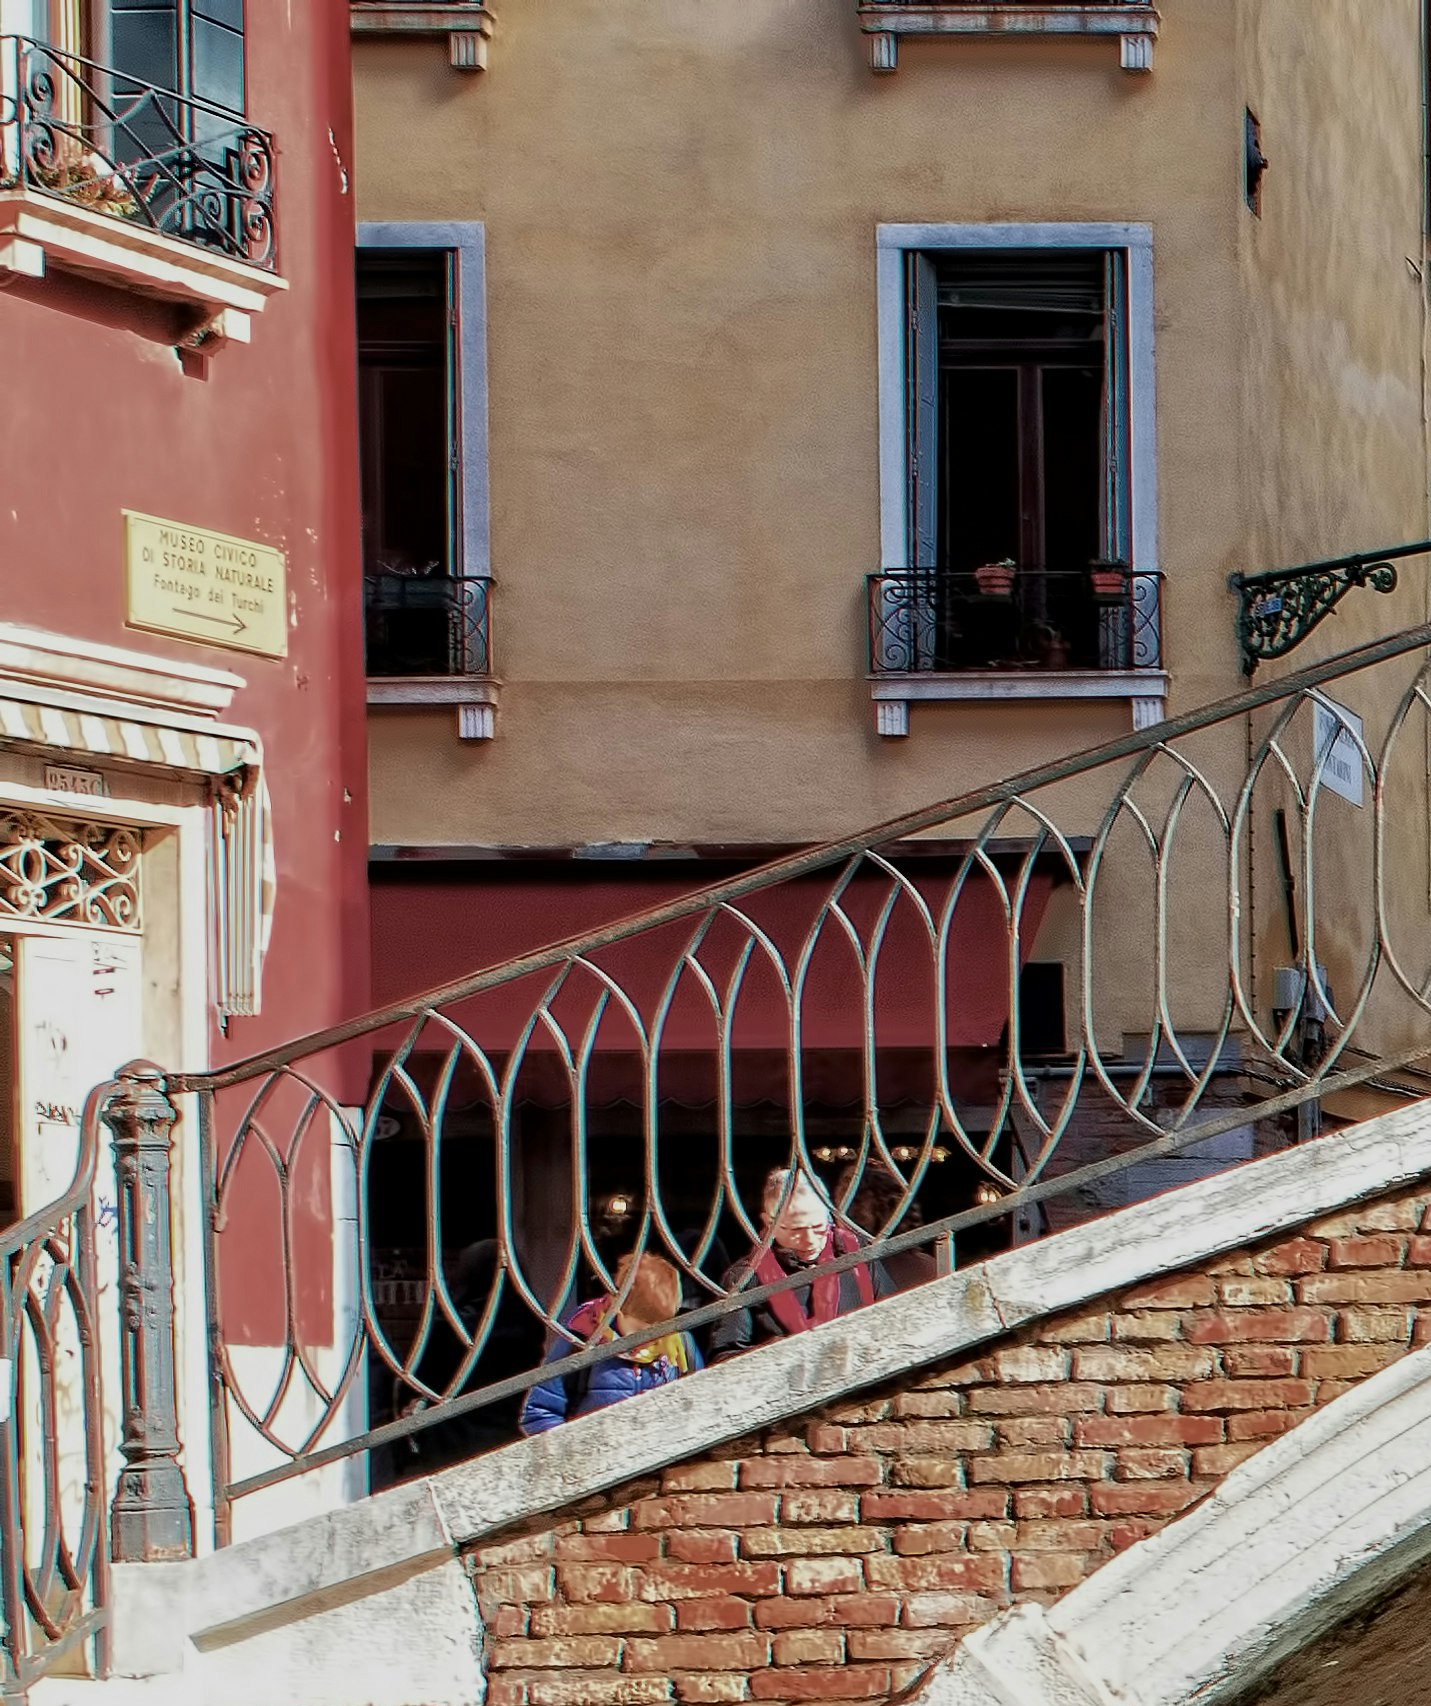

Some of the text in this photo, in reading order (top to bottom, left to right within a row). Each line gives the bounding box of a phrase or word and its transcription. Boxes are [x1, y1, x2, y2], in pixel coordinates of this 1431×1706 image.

[159, 529, 257, 568] MUSEO CIVICO
[142, 547, 274, 593] DI STORIA NATURALE
[154, 573, 264, 613] Fontego dei Turchi
